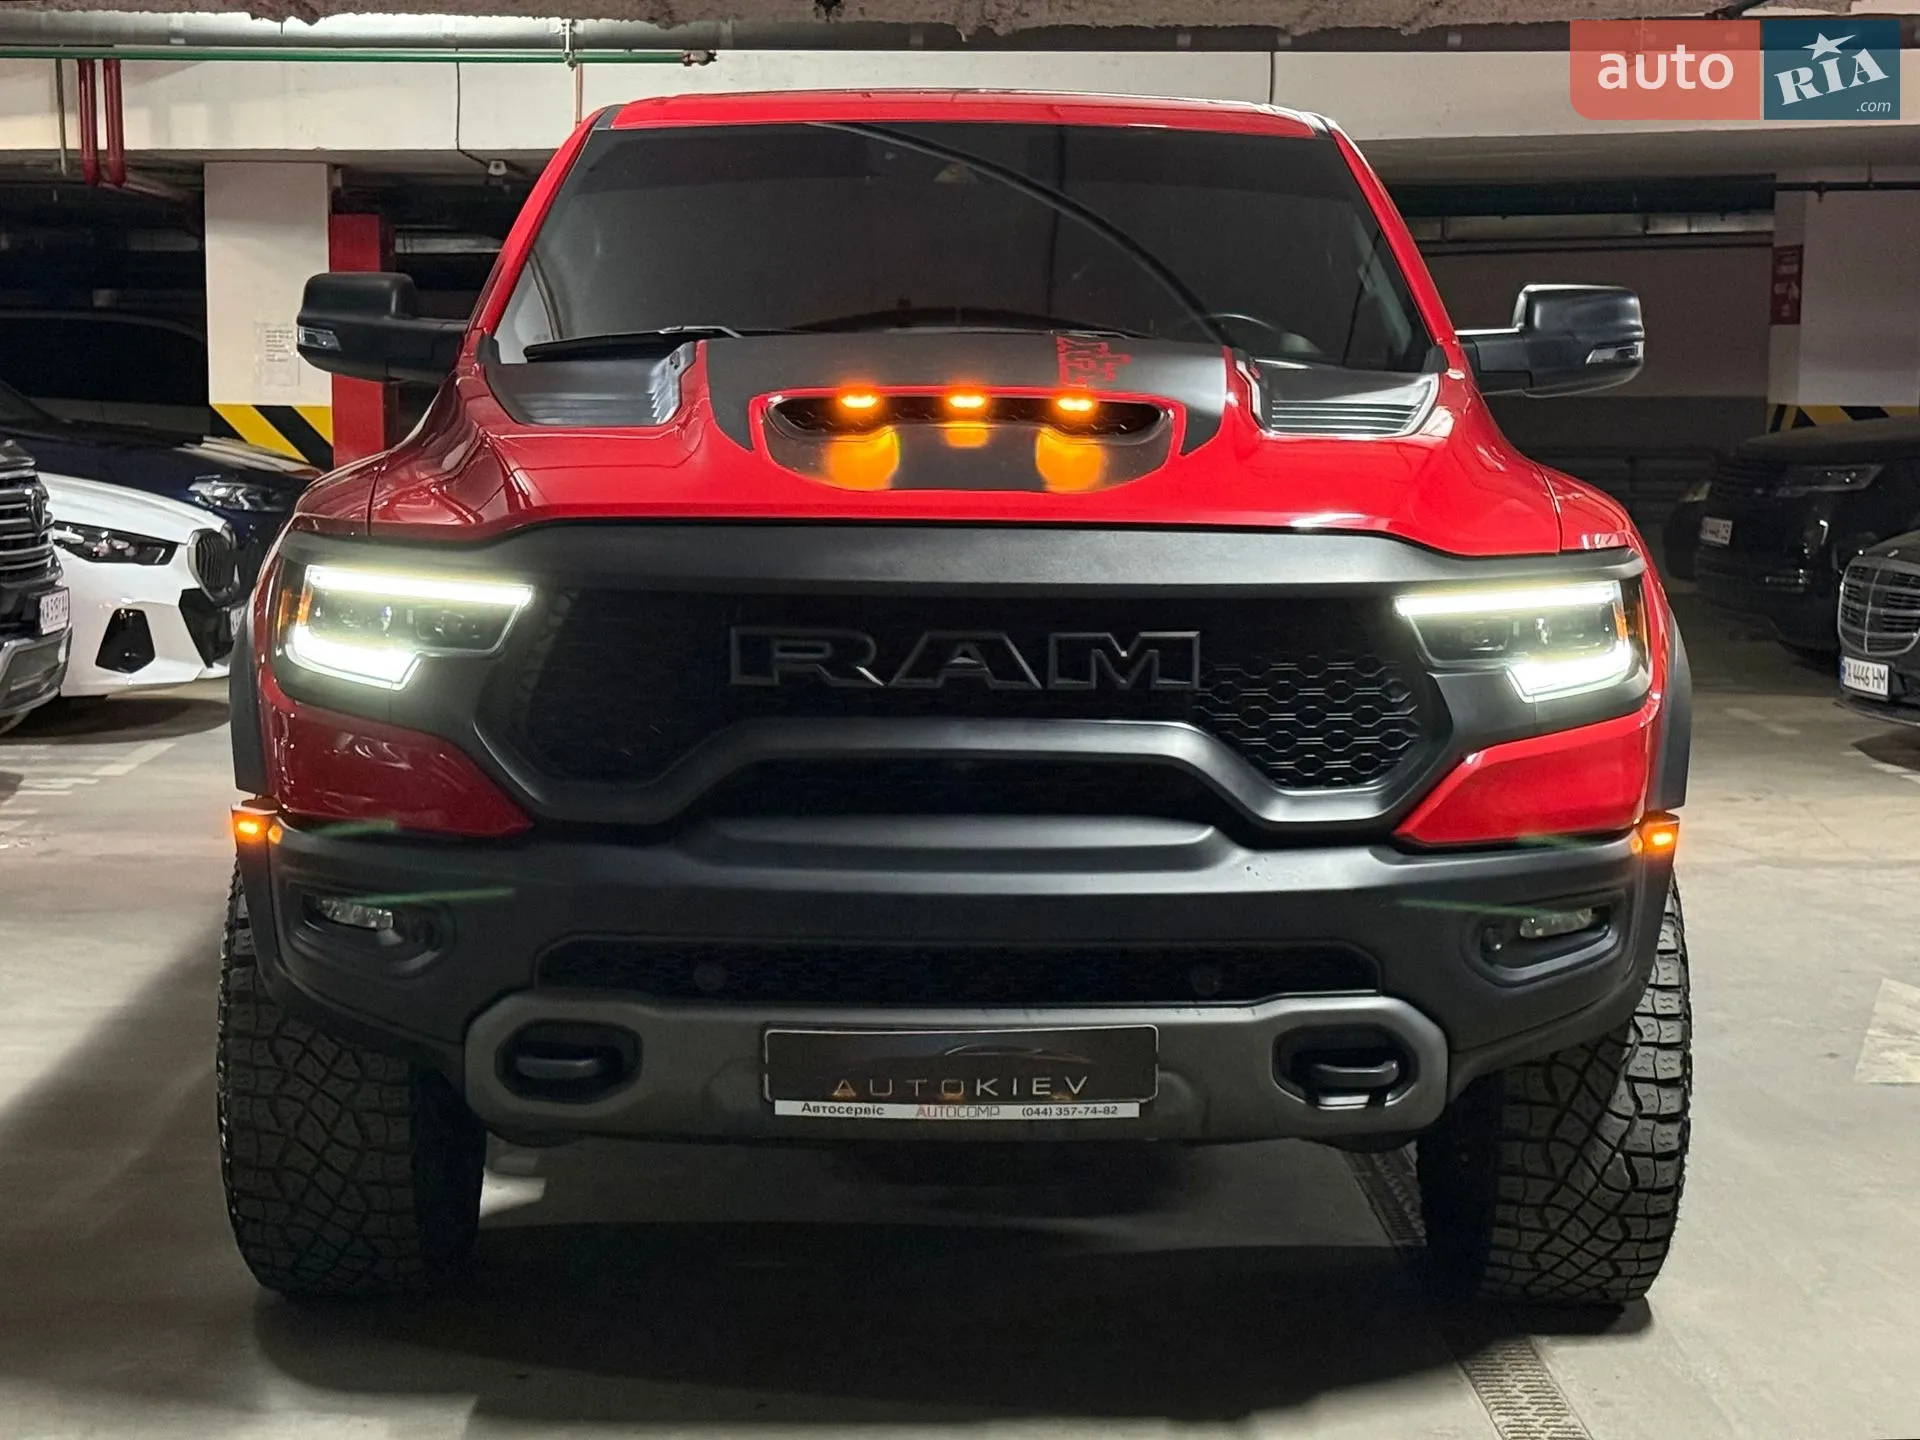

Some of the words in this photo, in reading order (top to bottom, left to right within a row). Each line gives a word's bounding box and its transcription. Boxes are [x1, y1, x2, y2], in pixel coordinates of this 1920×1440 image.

[730, 625, 1201, 690] RAM
[832, 1075, 1088, 1098] AUTOKIEV
[801, 1102, 885, 1116] Автосервіс
[1021, 1106, 1052, 1118] (044)
[1055, 1105, 1118, 1117] 357-74-82
